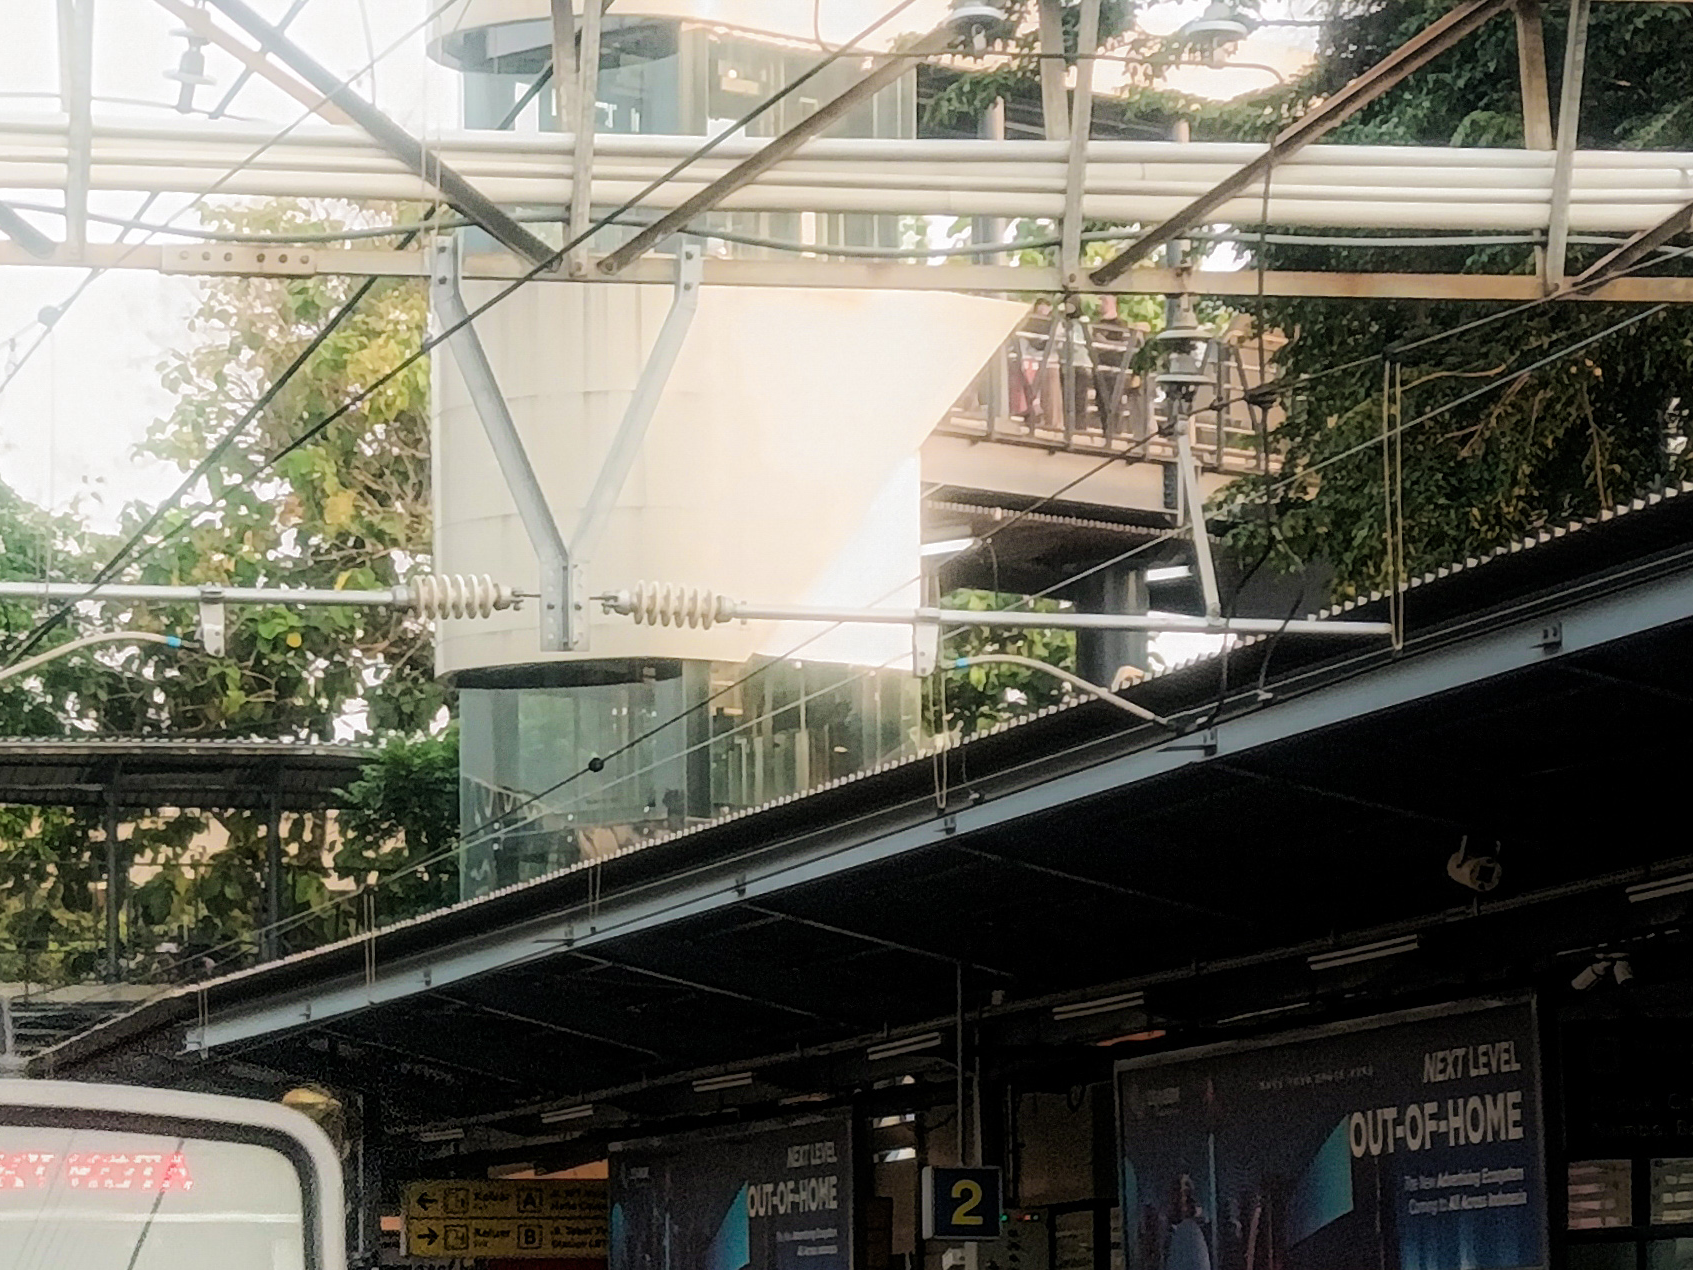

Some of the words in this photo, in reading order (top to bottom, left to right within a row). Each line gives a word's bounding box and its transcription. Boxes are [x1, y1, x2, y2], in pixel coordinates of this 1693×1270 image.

[1423, 1047, 1466, 1083] NEXT
[1468, 1041, 1521, 1077] LEVEL
[1349, 1091, 1524, 1158] OUT-OF-HOME
[523, 1193, 537, 1209] A
[748, 1175, 838, 1218] OUT-OF-HOME
[951, 1179, 984, 1225] 2
[524, 1229, 537, 1245] B
